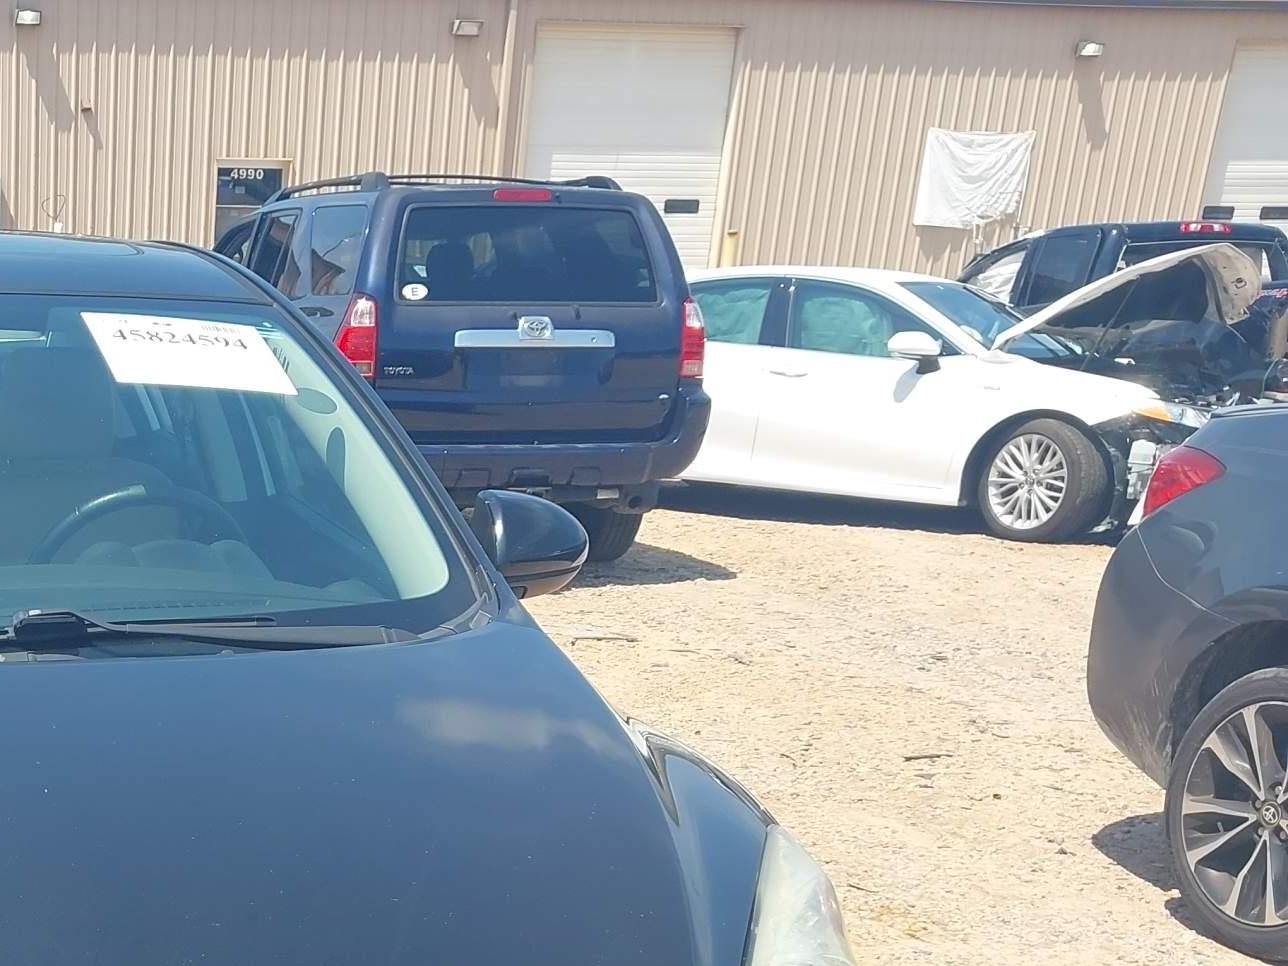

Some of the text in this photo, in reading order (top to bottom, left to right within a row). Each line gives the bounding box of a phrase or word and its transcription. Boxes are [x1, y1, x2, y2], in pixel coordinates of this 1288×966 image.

[230, 168, 265, 180] 4990
[112, 328, 249, 350] 45824594
[383, 366, 415, 376] TOYOTA
